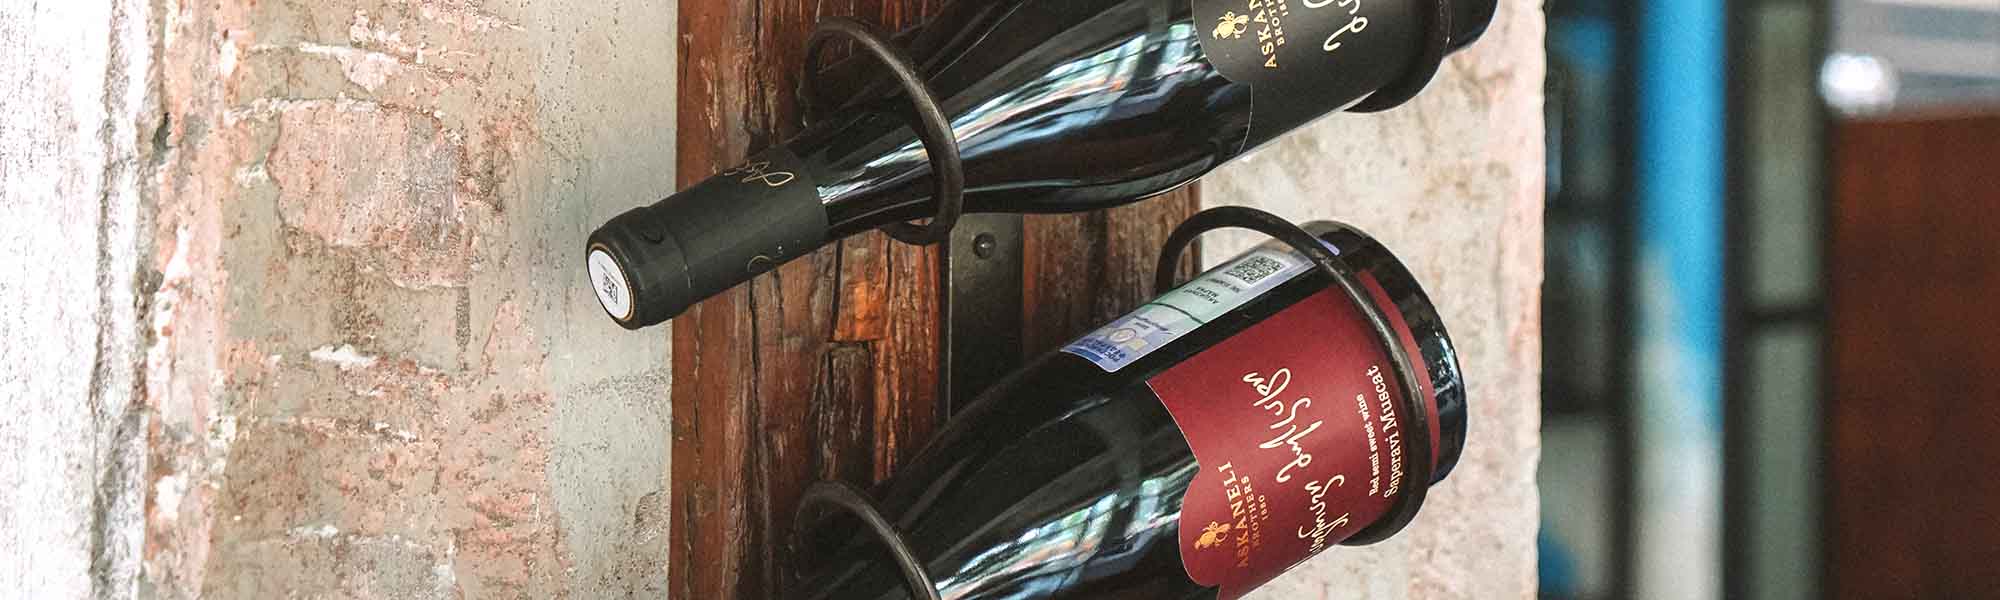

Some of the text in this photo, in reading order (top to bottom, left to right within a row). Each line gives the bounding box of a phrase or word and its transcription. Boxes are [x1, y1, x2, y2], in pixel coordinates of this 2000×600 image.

[1356, 393, 1380, 497] Red semi sweet wine
[1365, 365, 1404, 498] Saperavi Muscat
[1217, 461, 1248, 567] ASKANELI
[1241, 475, 1261, 548] BROTHERS
